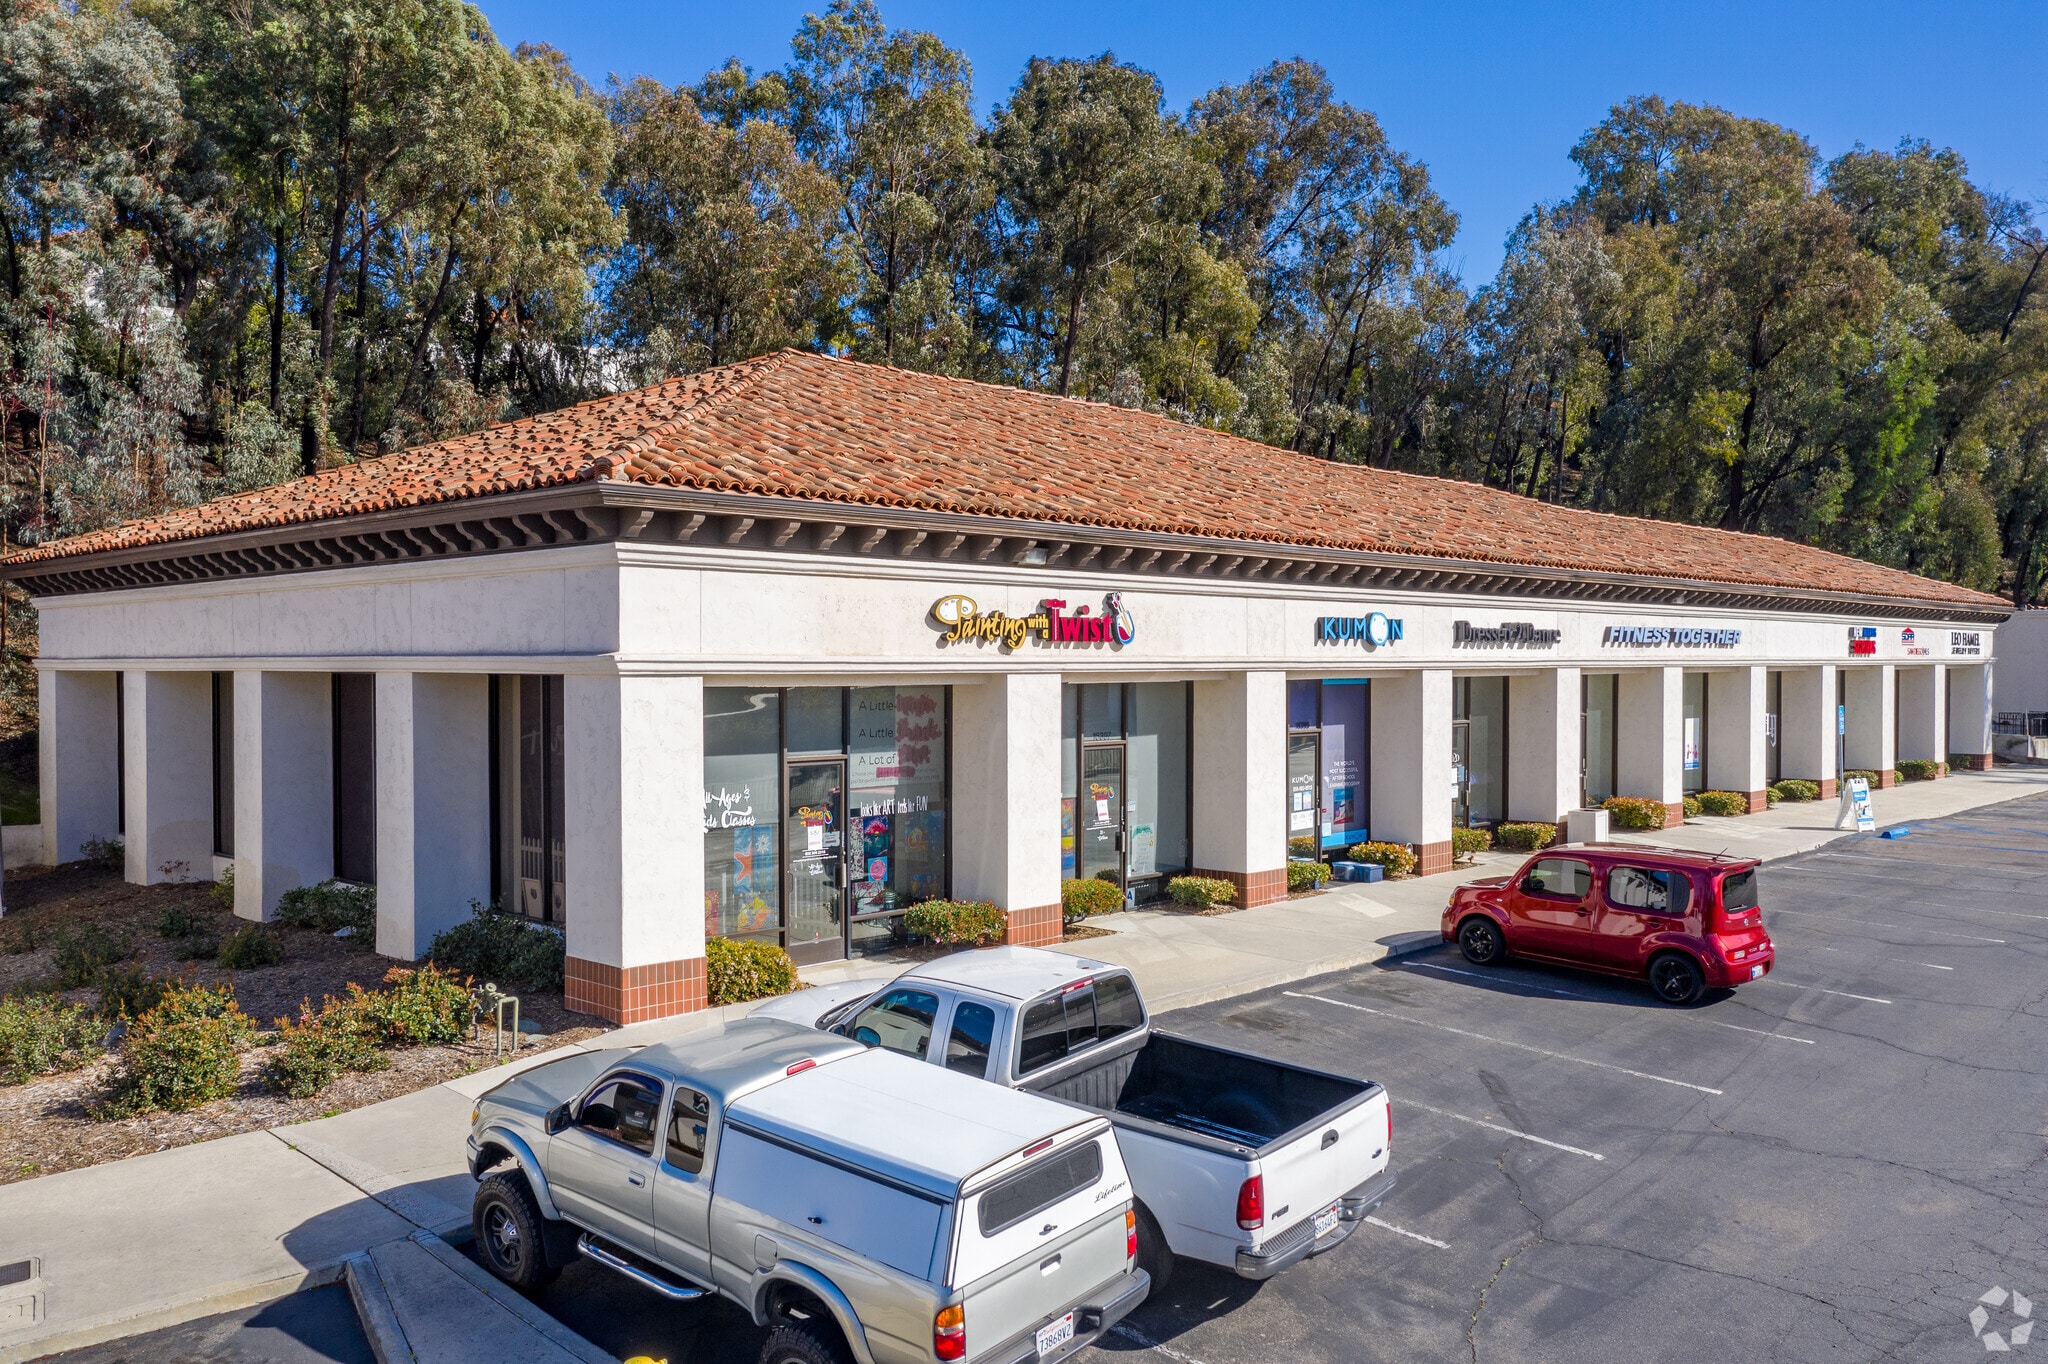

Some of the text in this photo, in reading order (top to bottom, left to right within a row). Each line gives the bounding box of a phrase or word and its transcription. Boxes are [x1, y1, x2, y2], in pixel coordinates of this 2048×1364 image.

[935, 594, 1049, 649] Painting with
[1046, 598, 1114, 642] Twist
[1323, 611, 1403, 647] KUMON
[1042, 629, 1049, 639] a
[1526, 623, 1561, 643] Dance
[1609, 626, 1742, 645] FITNESS TOGETHER
[1951, 631, 1980, 646] LEO HAMEL
[859, 701, 867, 710] A
[869, 701, 894, 711] Little
[859, 728, 894, 738] A Little
[859, 756, 866, 765] A
[869, 755, 884, 765] Lot
[886, 753, 896, 764] of
[1291, 774, 1313, 784] KUMON
[711, 787, 742, 810] Ages
[860, 801, 873, 817] looks
[872, 800, 881, 816] like
[882, 798, 895, 815] ART
[907, 798, 915, 813] like
[916, 795, 929, 812] FUN
[721, 806, 756, 828] Classes
[1094, 1180, 1126, 1203] Lifetime
